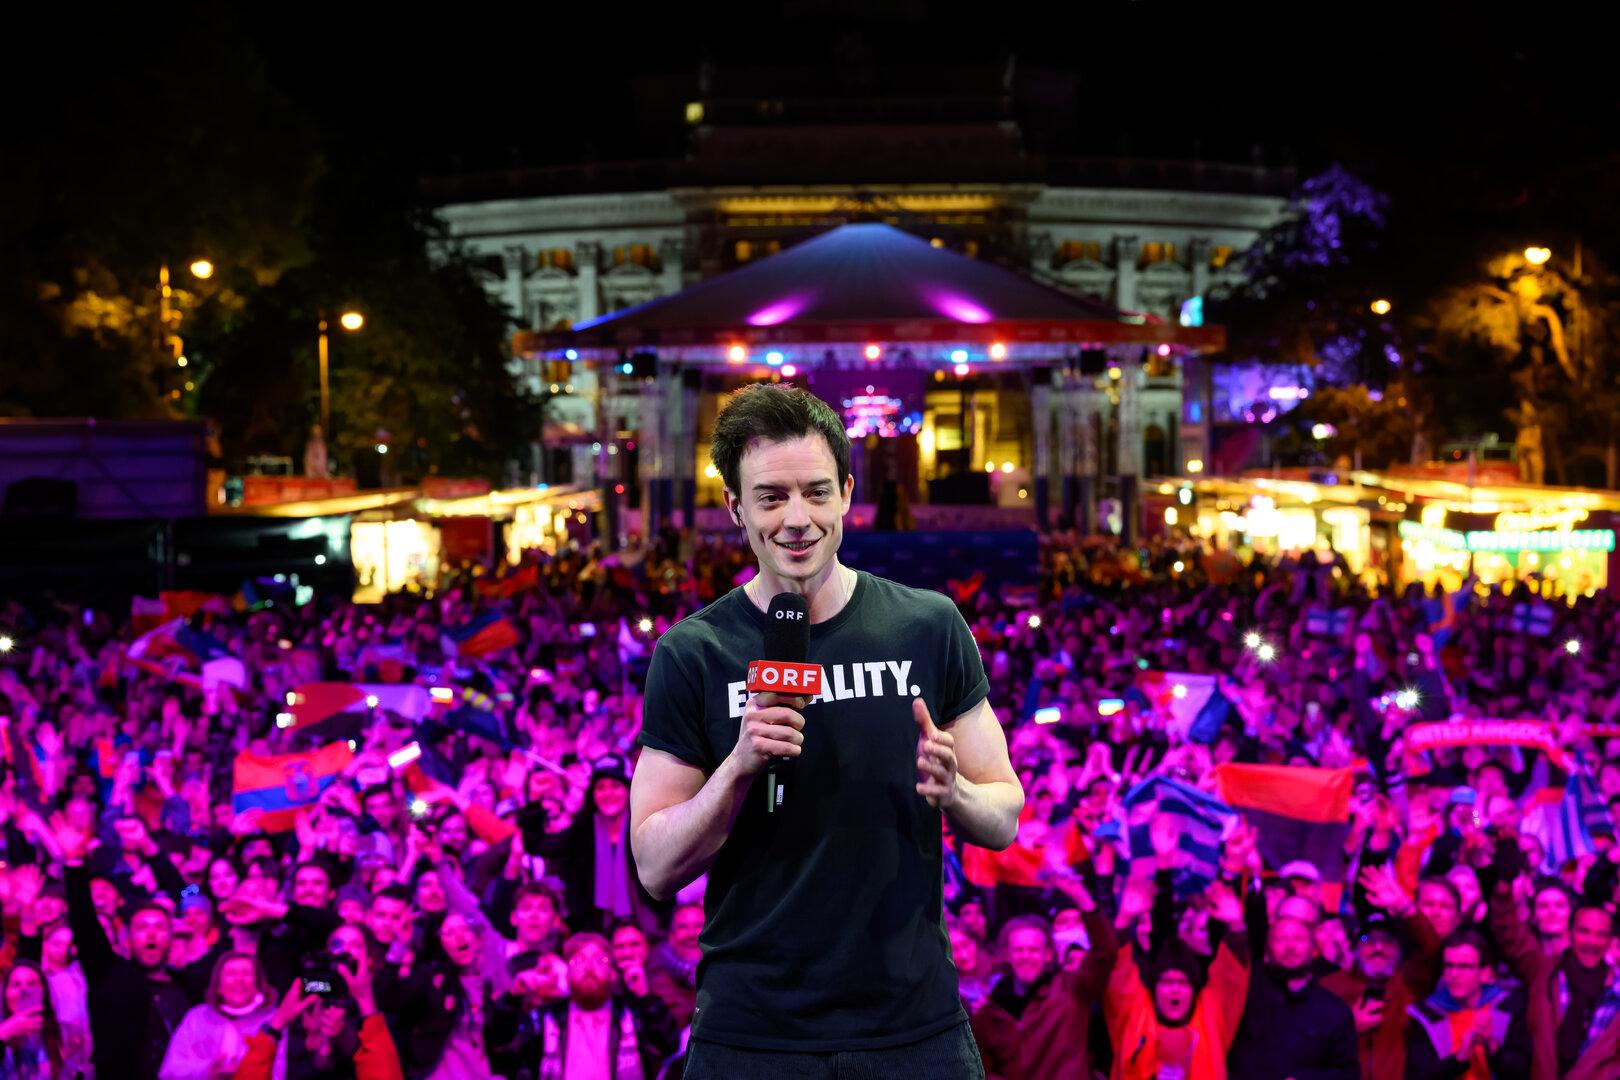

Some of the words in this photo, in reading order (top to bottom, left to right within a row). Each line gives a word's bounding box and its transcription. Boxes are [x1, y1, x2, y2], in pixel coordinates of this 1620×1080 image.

[775, 610, 804, 620] ORF
[761, 667, 818, 687] ORF
[727, 660, 921, 719] EALITY.
